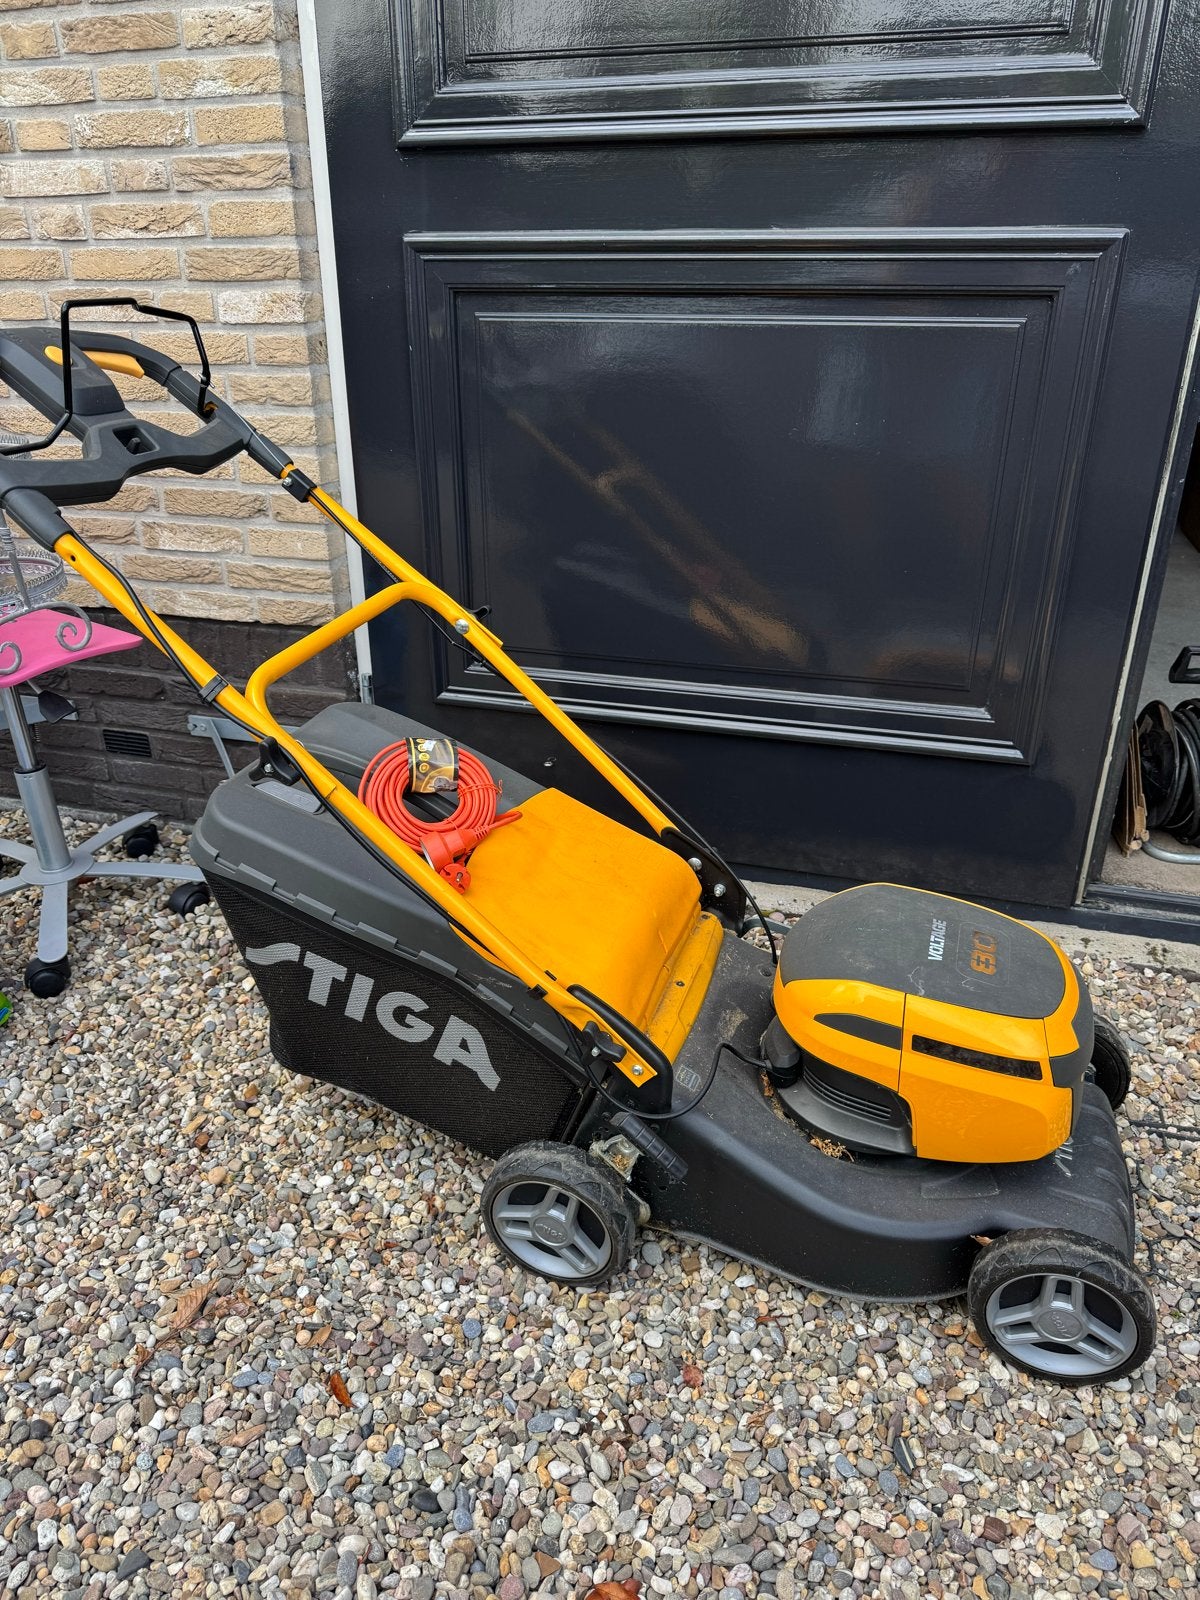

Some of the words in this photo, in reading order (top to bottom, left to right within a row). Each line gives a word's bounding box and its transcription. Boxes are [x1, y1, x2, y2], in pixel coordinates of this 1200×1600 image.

[927, 918, 947, 961] VOLTAGE
[970, 930, 997, 976] 80
[245, 942, 501, 1092] STIGA
